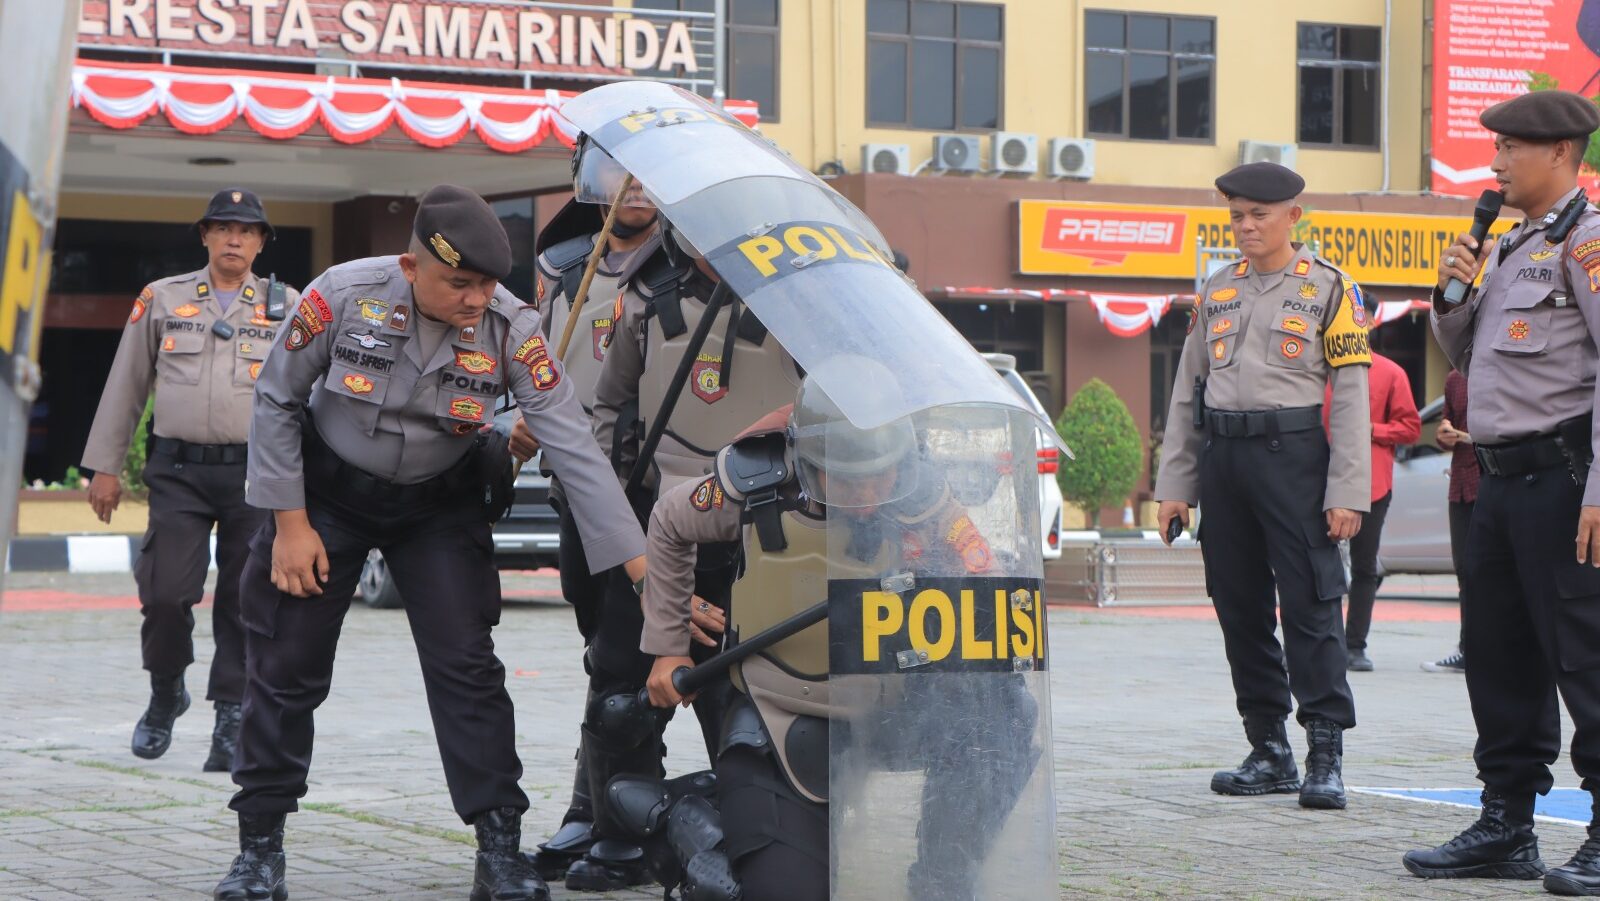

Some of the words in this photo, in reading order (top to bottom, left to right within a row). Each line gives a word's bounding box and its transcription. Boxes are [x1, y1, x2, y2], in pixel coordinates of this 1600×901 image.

[340, 1, 698, 73] SAMARINDA
[1058, 218, 1175, 245] PRESISI
[737, 226, 888, 279] POL
[1516, 267, 1552, 281] POLRI
[1207, 300, 1241, 319] BAHAR
[1281, 299, 1324, 319] POLRI
[441, 371, 499, 395] POLRI
[861, 588, 1044, 662] POLISI
